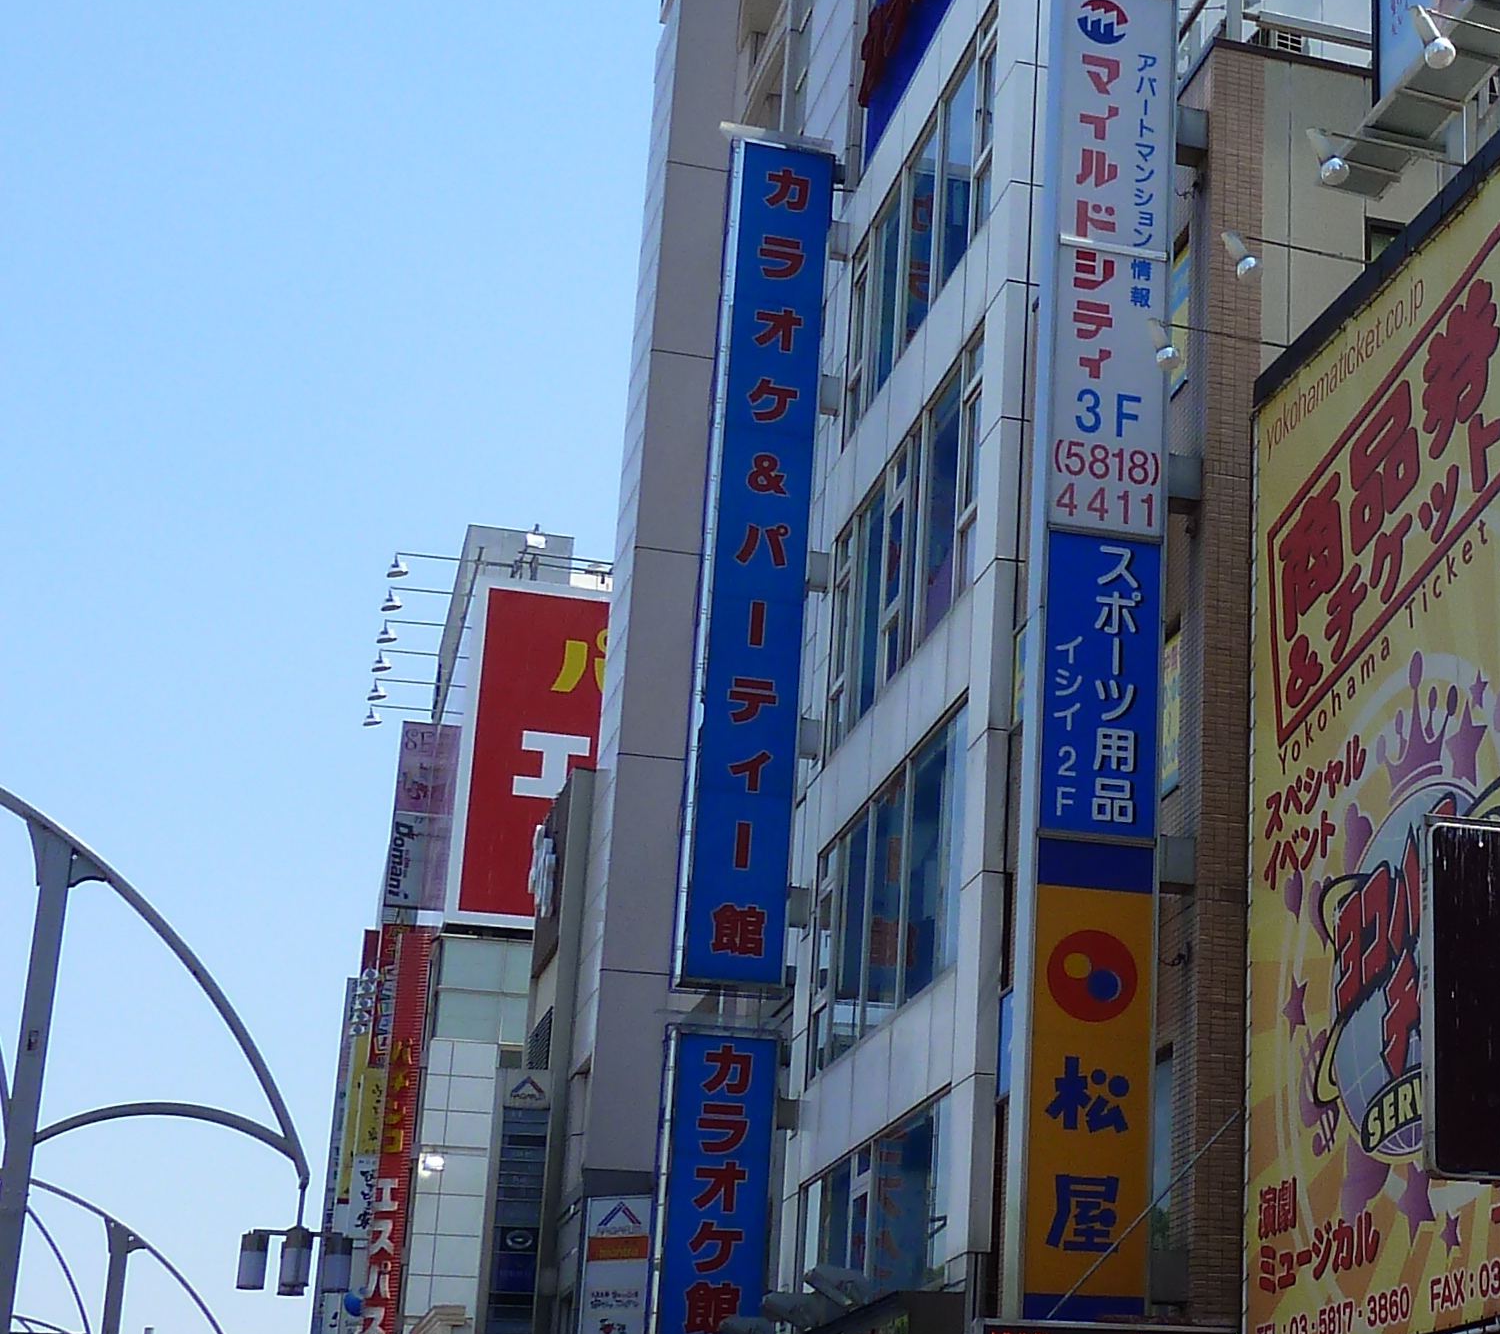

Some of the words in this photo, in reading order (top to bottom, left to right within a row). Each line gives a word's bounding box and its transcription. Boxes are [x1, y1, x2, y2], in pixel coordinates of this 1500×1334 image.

[1072, 52, 1122, 381] マイルドシティ
[1129, 53, 1158, 309] アパートマンション情報
[1074, 387, 1143, 438] 3F
[1264, 277, 1425, 463] yokohamaticket.co.jp
[1054, 438, 1160, 487] (5818)
[1055, 482, 1156, 529] 4411
[708, 165, 812, 960] カラオケ&パーティー館
[1091, 543, 1143, 826] スポーツ用品
[1278, 634, 1392, 775] Yokohama
[1403, 517, 1491, 630] Ticket
[1262, 808, 1337, 891] イベント
[1264, 733, 1368, 841] スペシャル
[1045, 1054, 1131, 1256] 松屋
[1257, 1175, 1298, 1241] 演劇
[1257, 1208, 1381, 1295] ミュージカル
